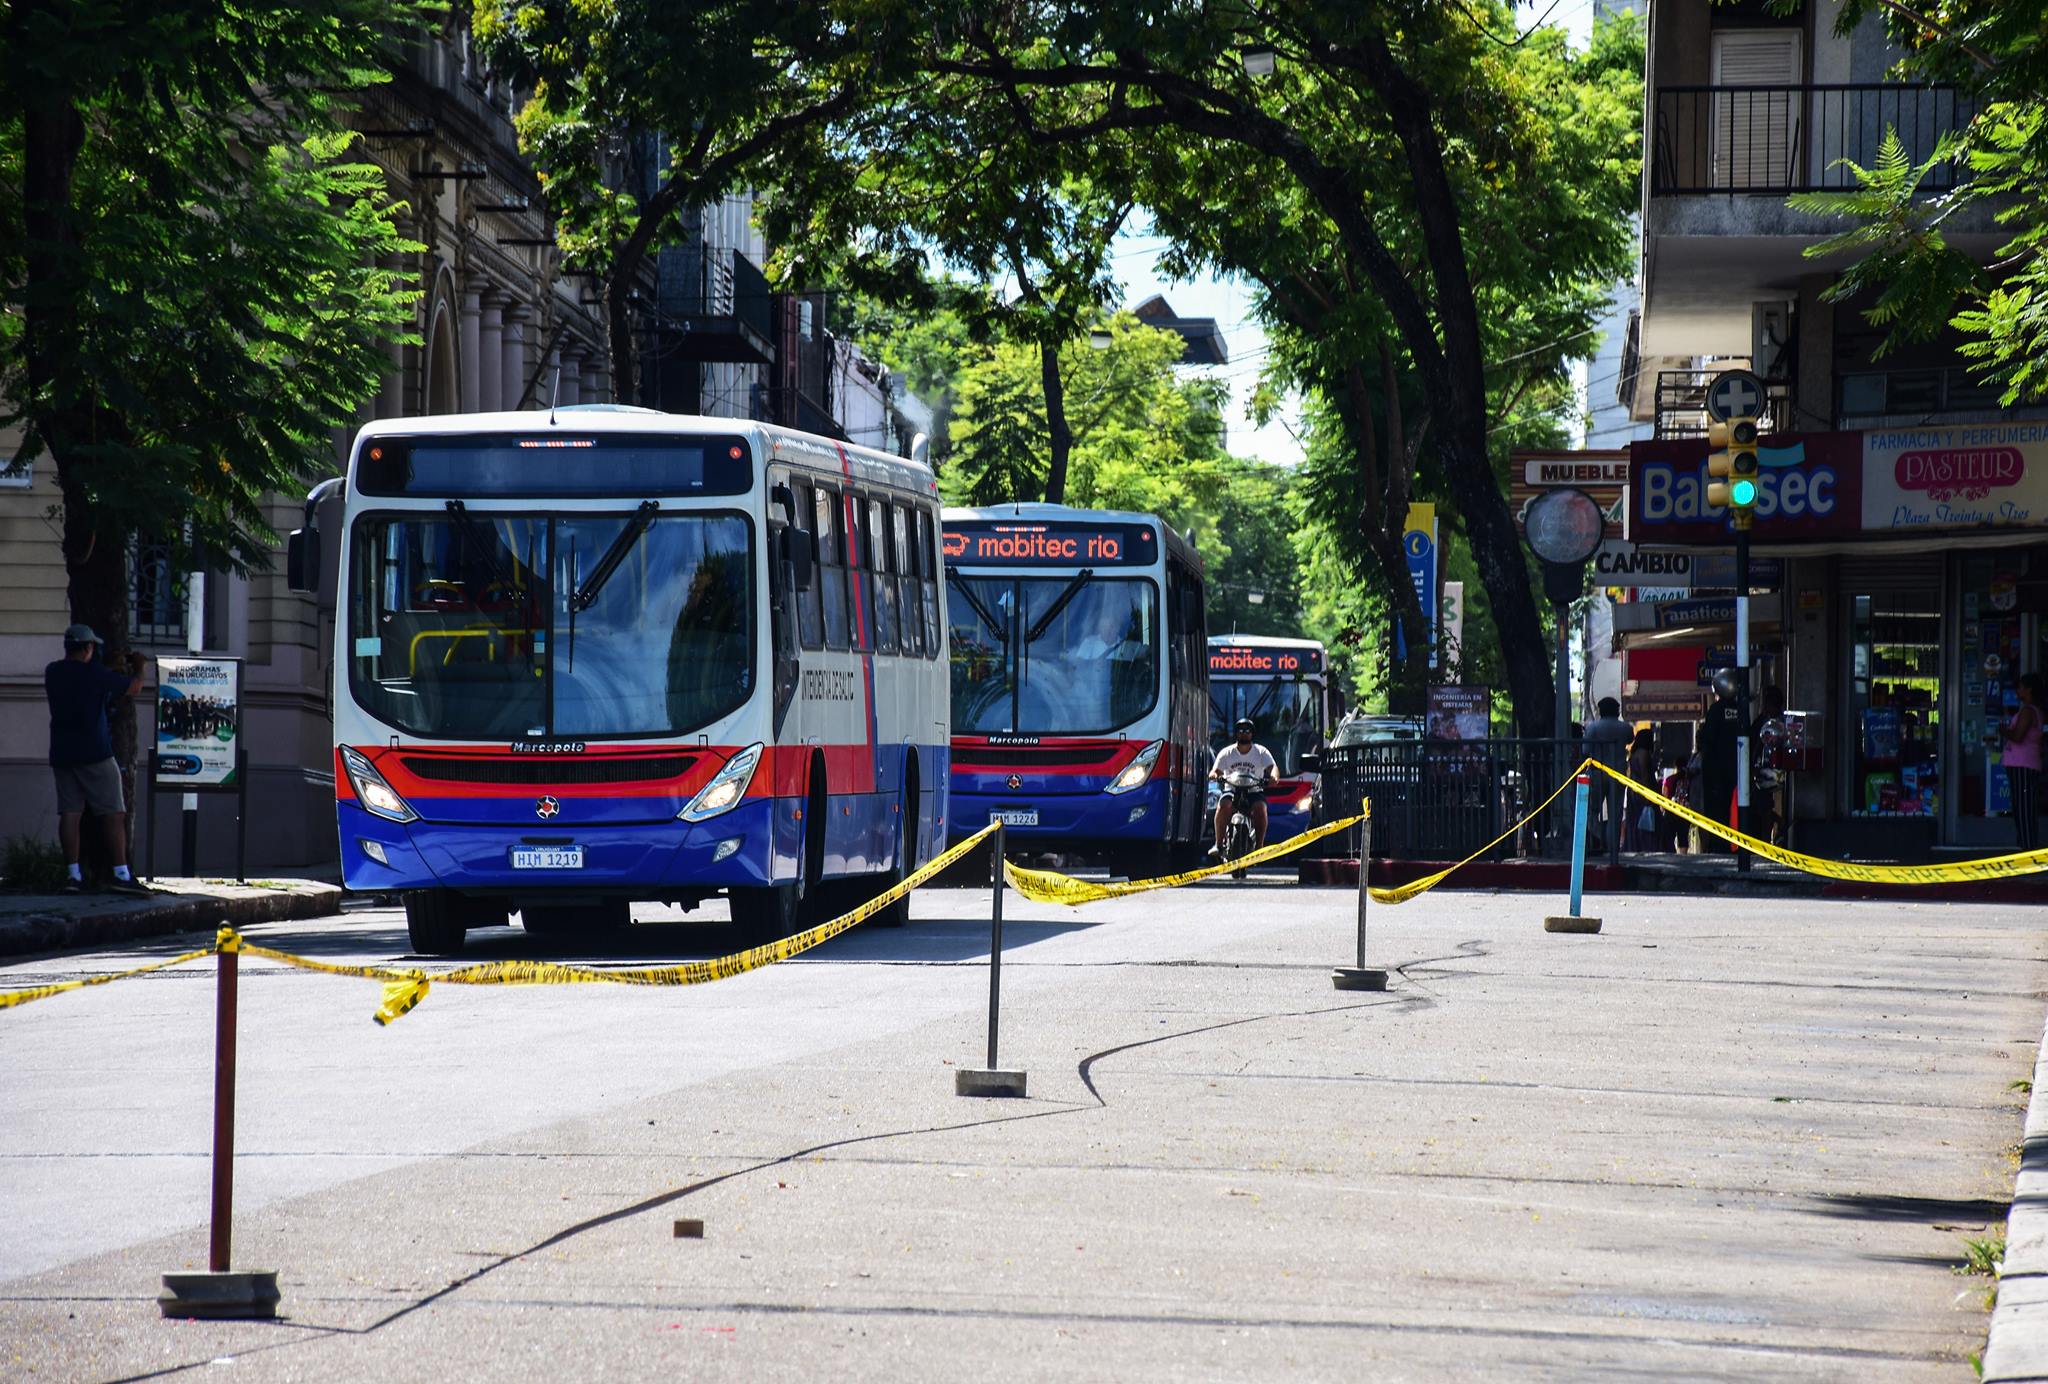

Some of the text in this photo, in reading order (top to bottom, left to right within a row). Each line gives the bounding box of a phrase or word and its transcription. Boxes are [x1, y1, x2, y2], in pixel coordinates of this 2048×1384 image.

[1871, 431, 1940, 450] FARMACIA
[1946, 431, 1955, 446] Y
[1540, 464, 1630, 480] MUEBLE
[1905, 451, 2015, 483] PASTEUR
[1643, 462, 1835, 529] Babsec
[1892, 501, 2030, 528] Plaza Treinta y Tres
[978, 534, 1118, 558] mobitec rio
[1597, 552, 1690, 575] CAMBIO
[1210, 653, 1298, 669] mobitec rio
[512, 742, 584, 753] Marcopolo
[989, 736, 1039, 745] Marcopolo
[1013, 814, 1036, 825] 1226
[547, 854, 579, 867] 1219
